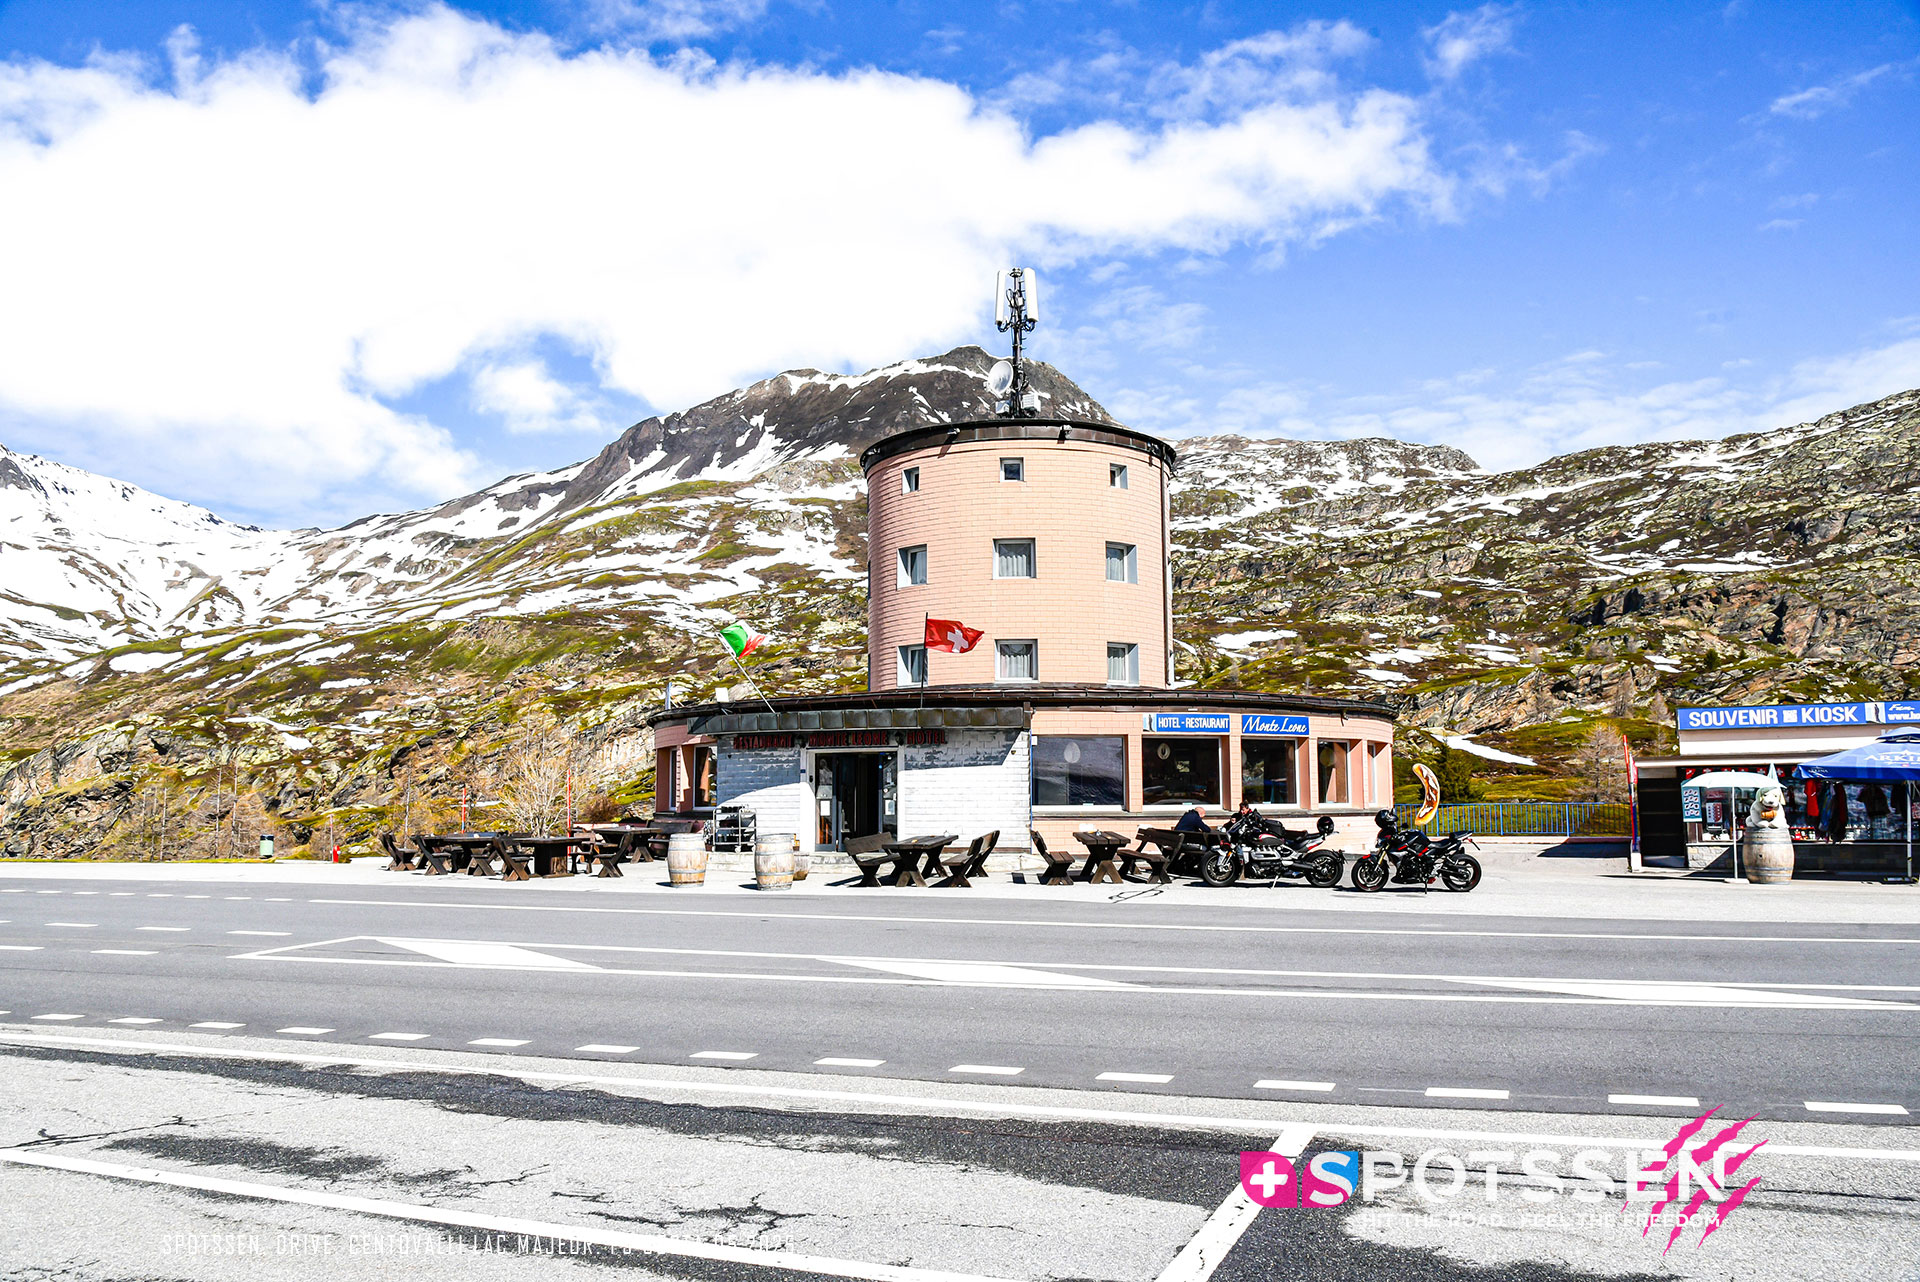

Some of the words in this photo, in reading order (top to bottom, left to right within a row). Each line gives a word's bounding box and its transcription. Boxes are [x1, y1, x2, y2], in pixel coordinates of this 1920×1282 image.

[1158, 717, 1181, 729] HOTEL
[1185, 717, 1230, 730] RESTAURANT
[1242, 716, 1280, 733] Monte
[1279, 717, 1308, 733] Leone
[1688, 708, 1778, 727] SOUVENIR
[1801, 705, 1859, 723] KIOSK
[808, 732, 848, 747] MONTE
[851, 731, 890, 746] LEONE
[907, 730, 947, 745] HOTEL
